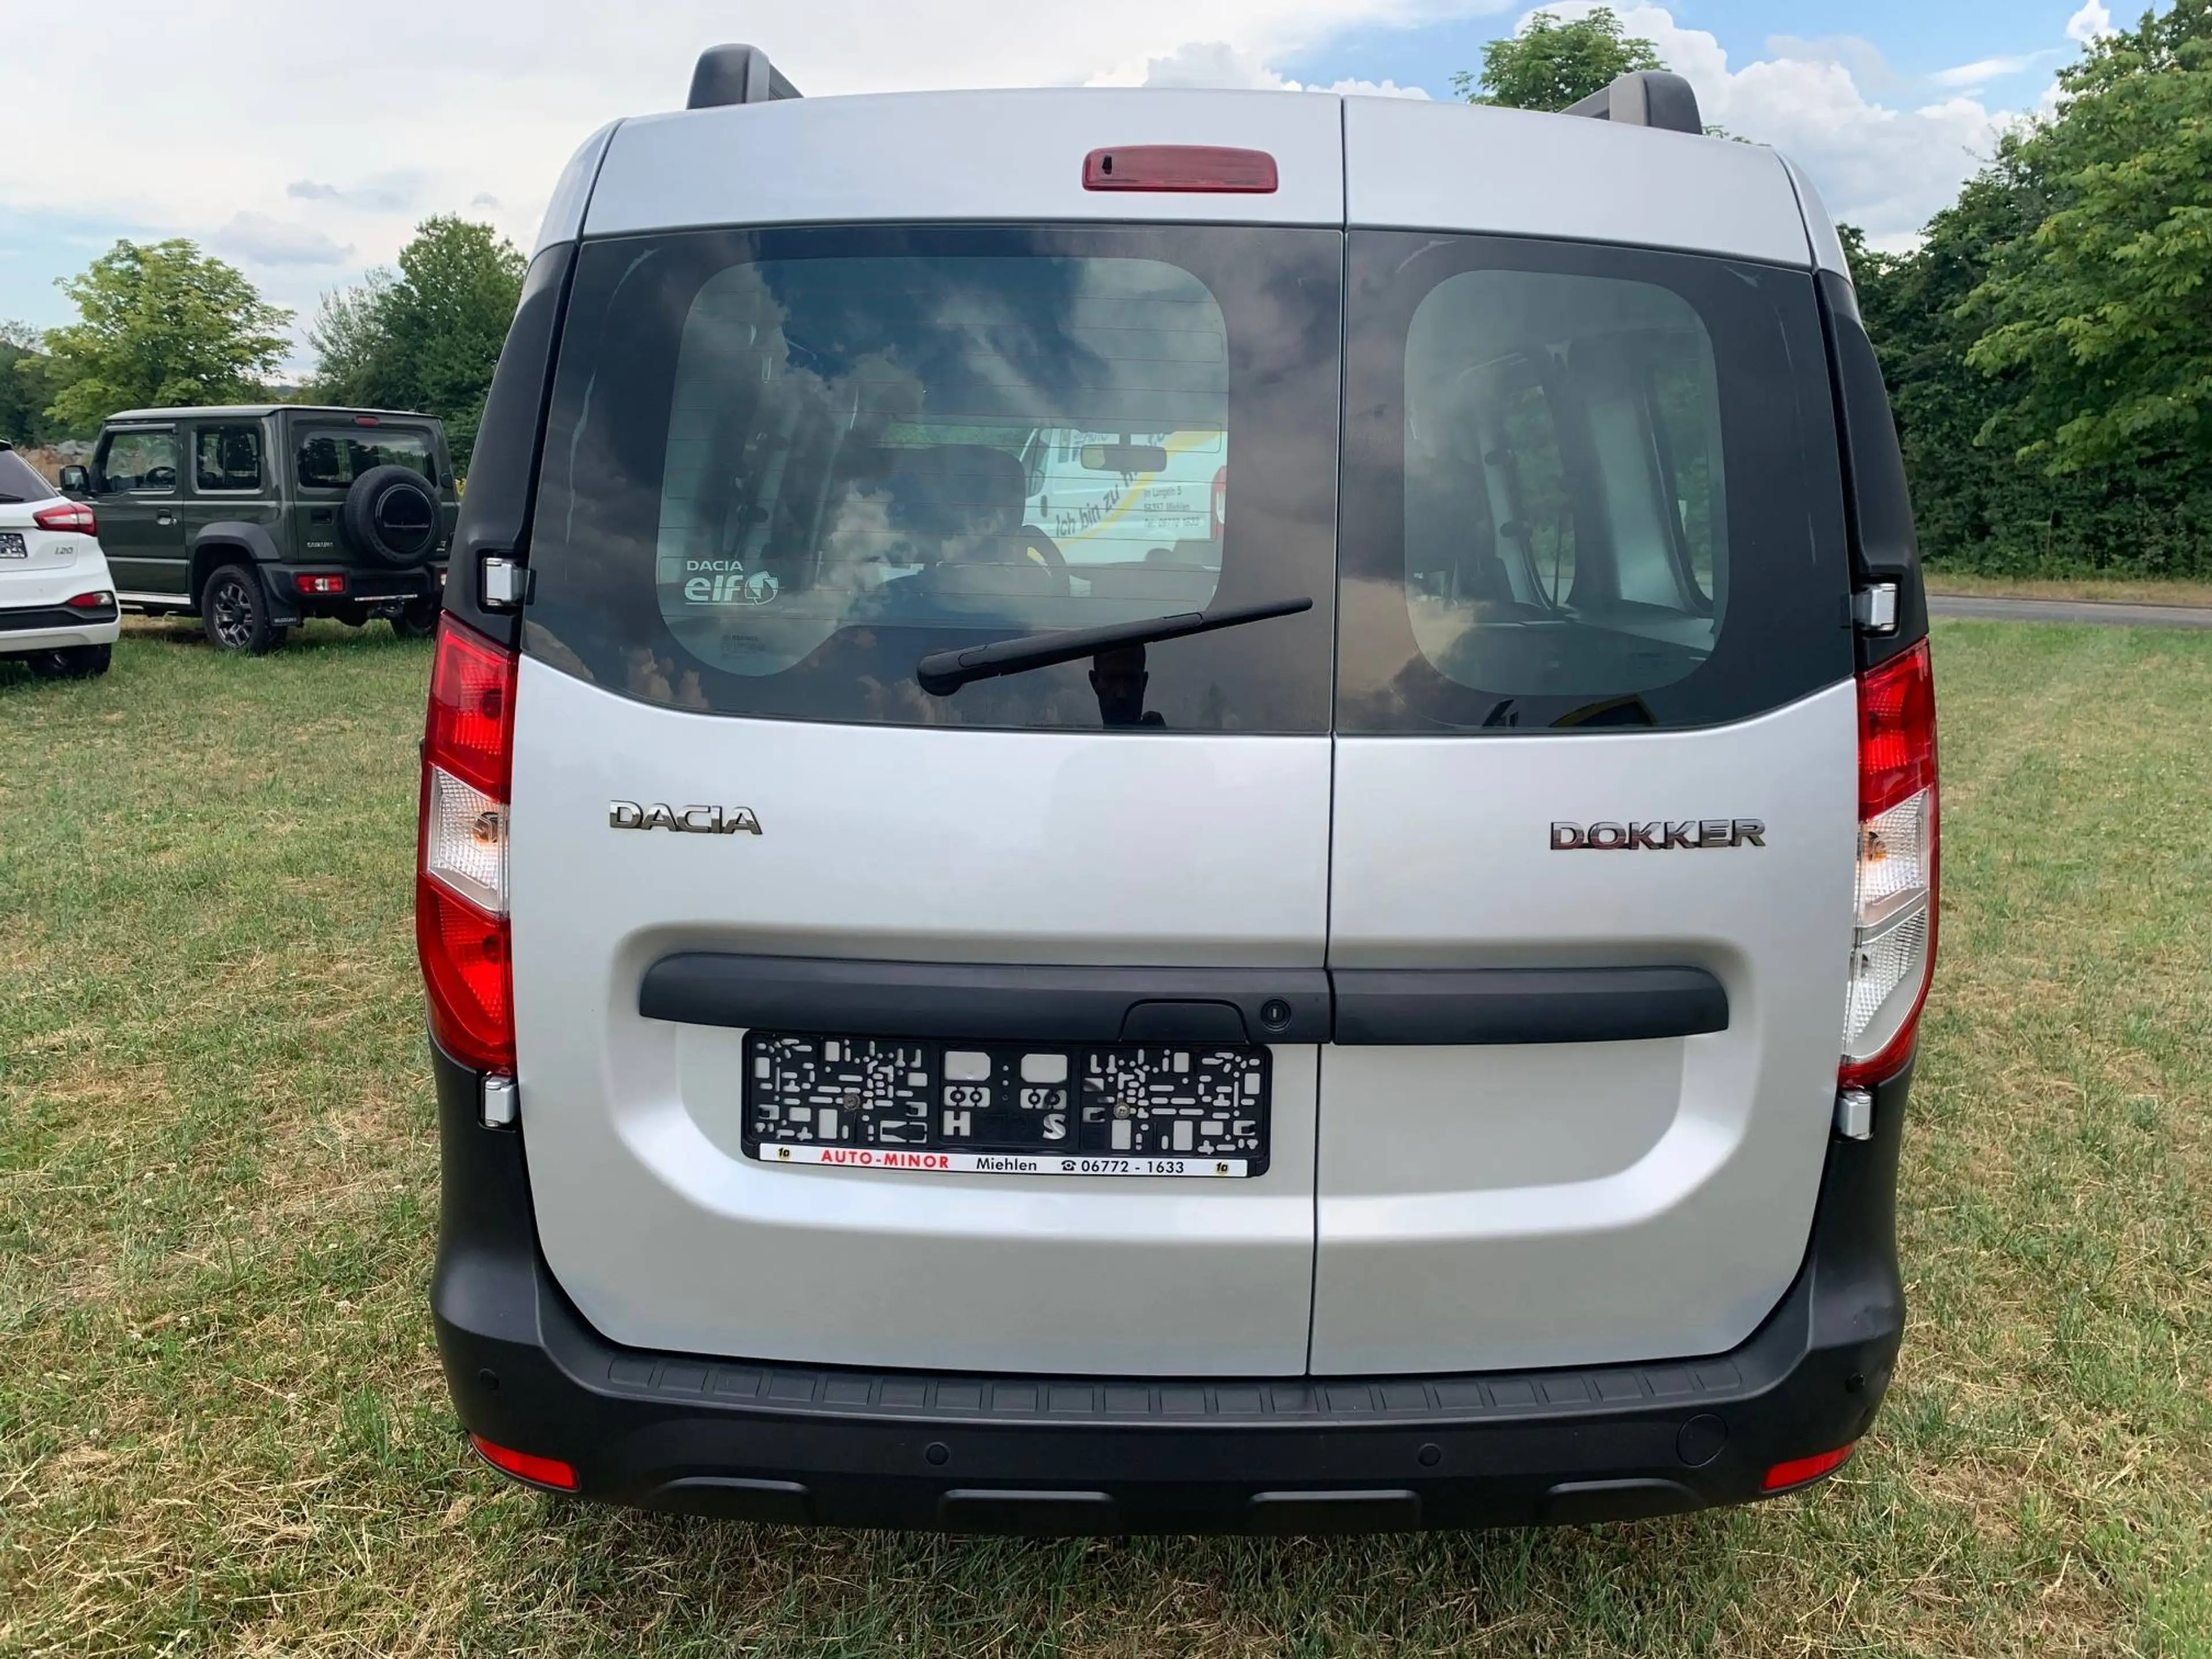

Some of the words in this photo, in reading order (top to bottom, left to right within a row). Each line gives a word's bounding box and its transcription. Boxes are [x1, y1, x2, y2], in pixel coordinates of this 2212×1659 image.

[1056, 512, 1076, 536] Ich
[1079, 503, 1101, 530] bin
[1103, 484, 1120, 513] zu
[687, 560, 744, 571] DACIA
[684, 575, 744, 602] elf
[609, 800, 763, 835] DACIA
[1550, 818, 1767, 850] DOKKER
[821, 1149, 949, 1169] AUTO-MINOR
[976, 1157, 1037, 1171] Miehlen
[1081, 1160, 1129, 1173] 06772
[1147, 1161, 1184, 1173] 1633
